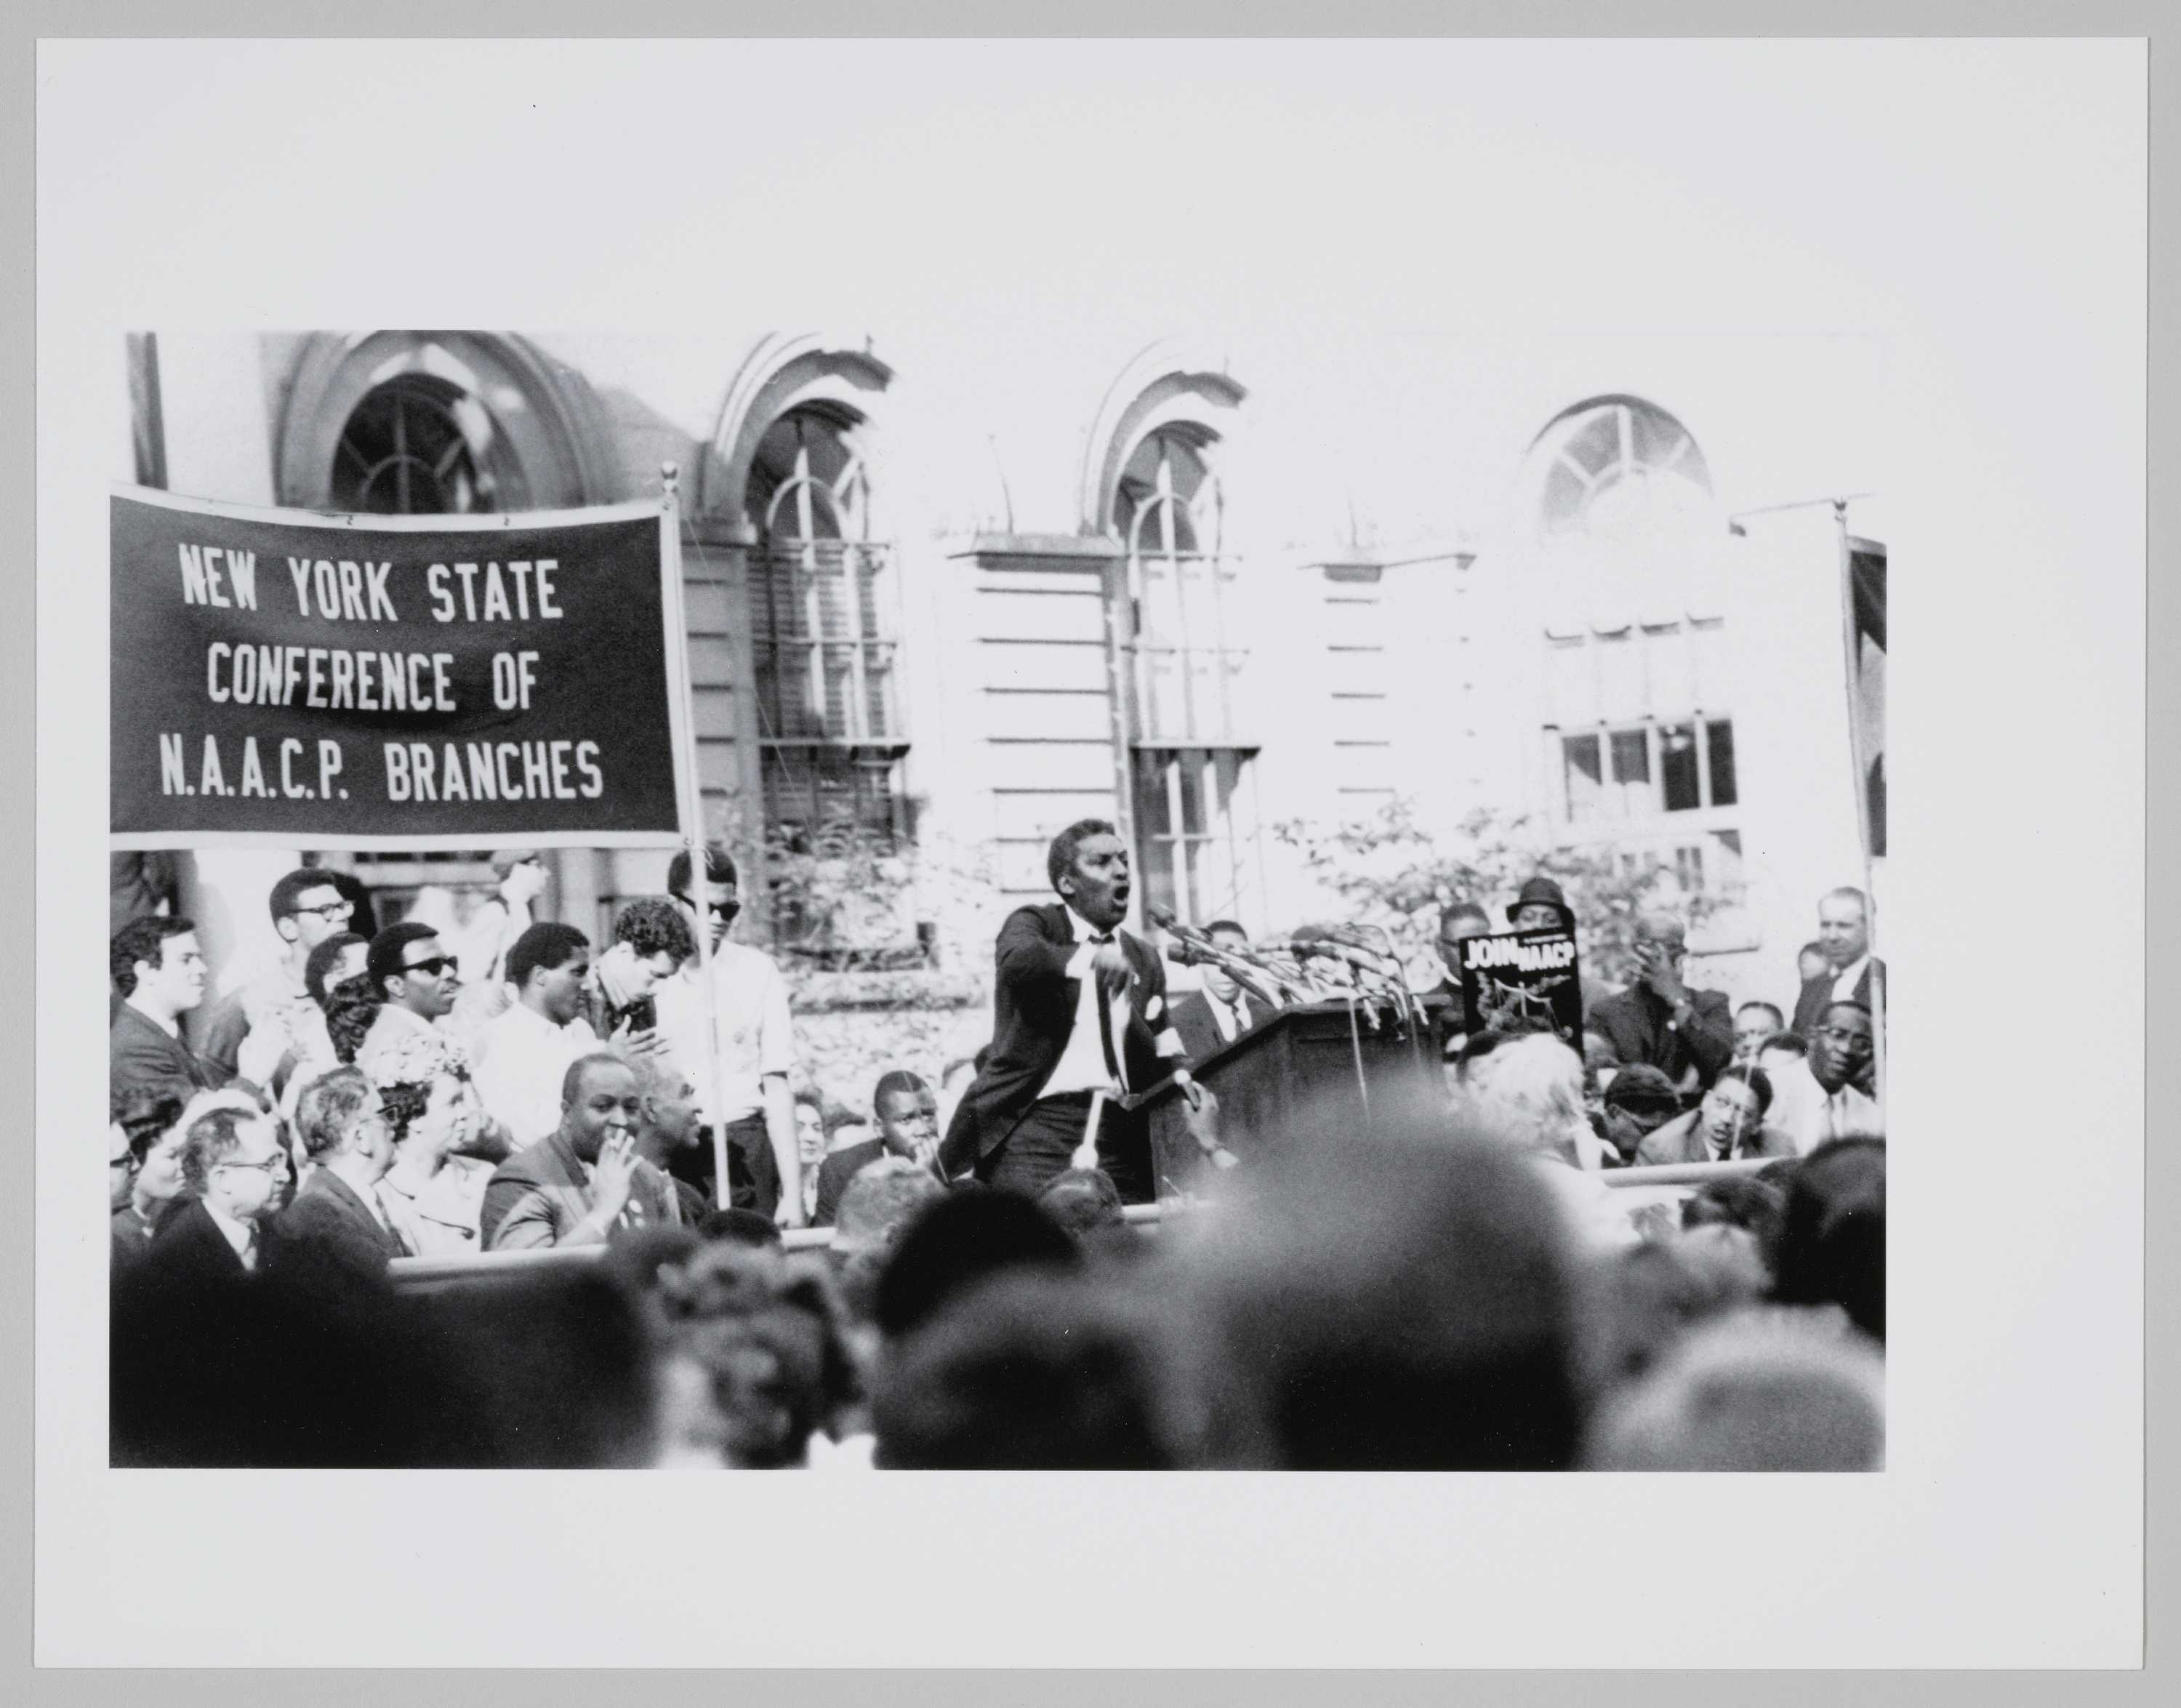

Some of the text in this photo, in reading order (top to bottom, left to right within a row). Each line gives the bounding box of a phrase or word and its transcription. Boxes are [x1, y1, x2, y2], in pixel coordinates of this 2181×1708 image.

[178, 543, 563, 621] NEW YORK STATE
[209, 642, 539, 710] CONFERENCE OF
[160, 733, 602, 801] N.A.A.C.P. BRANCHES
[1463, 937, 1519, 970] JOIN
